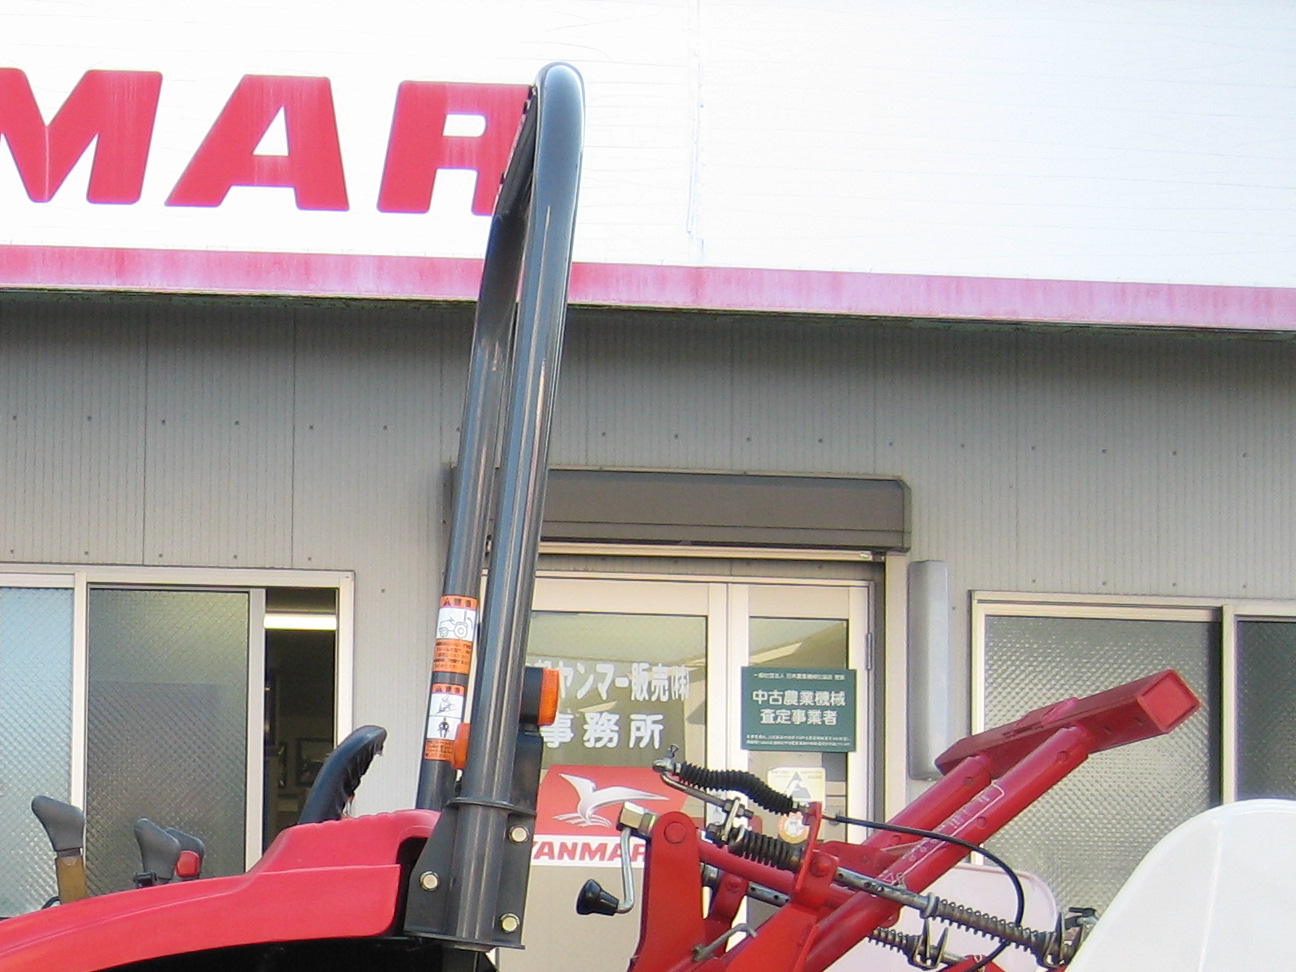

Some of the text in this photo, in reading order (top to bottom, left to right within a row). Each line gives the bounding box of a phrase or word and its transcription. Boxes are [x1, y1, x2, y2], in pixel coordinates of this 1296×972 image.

[752, 689, 846, 706] 中古農業機械
[760, 708, 839, 725] 査定事業者
[540, 711, 664, 749] 事務所
